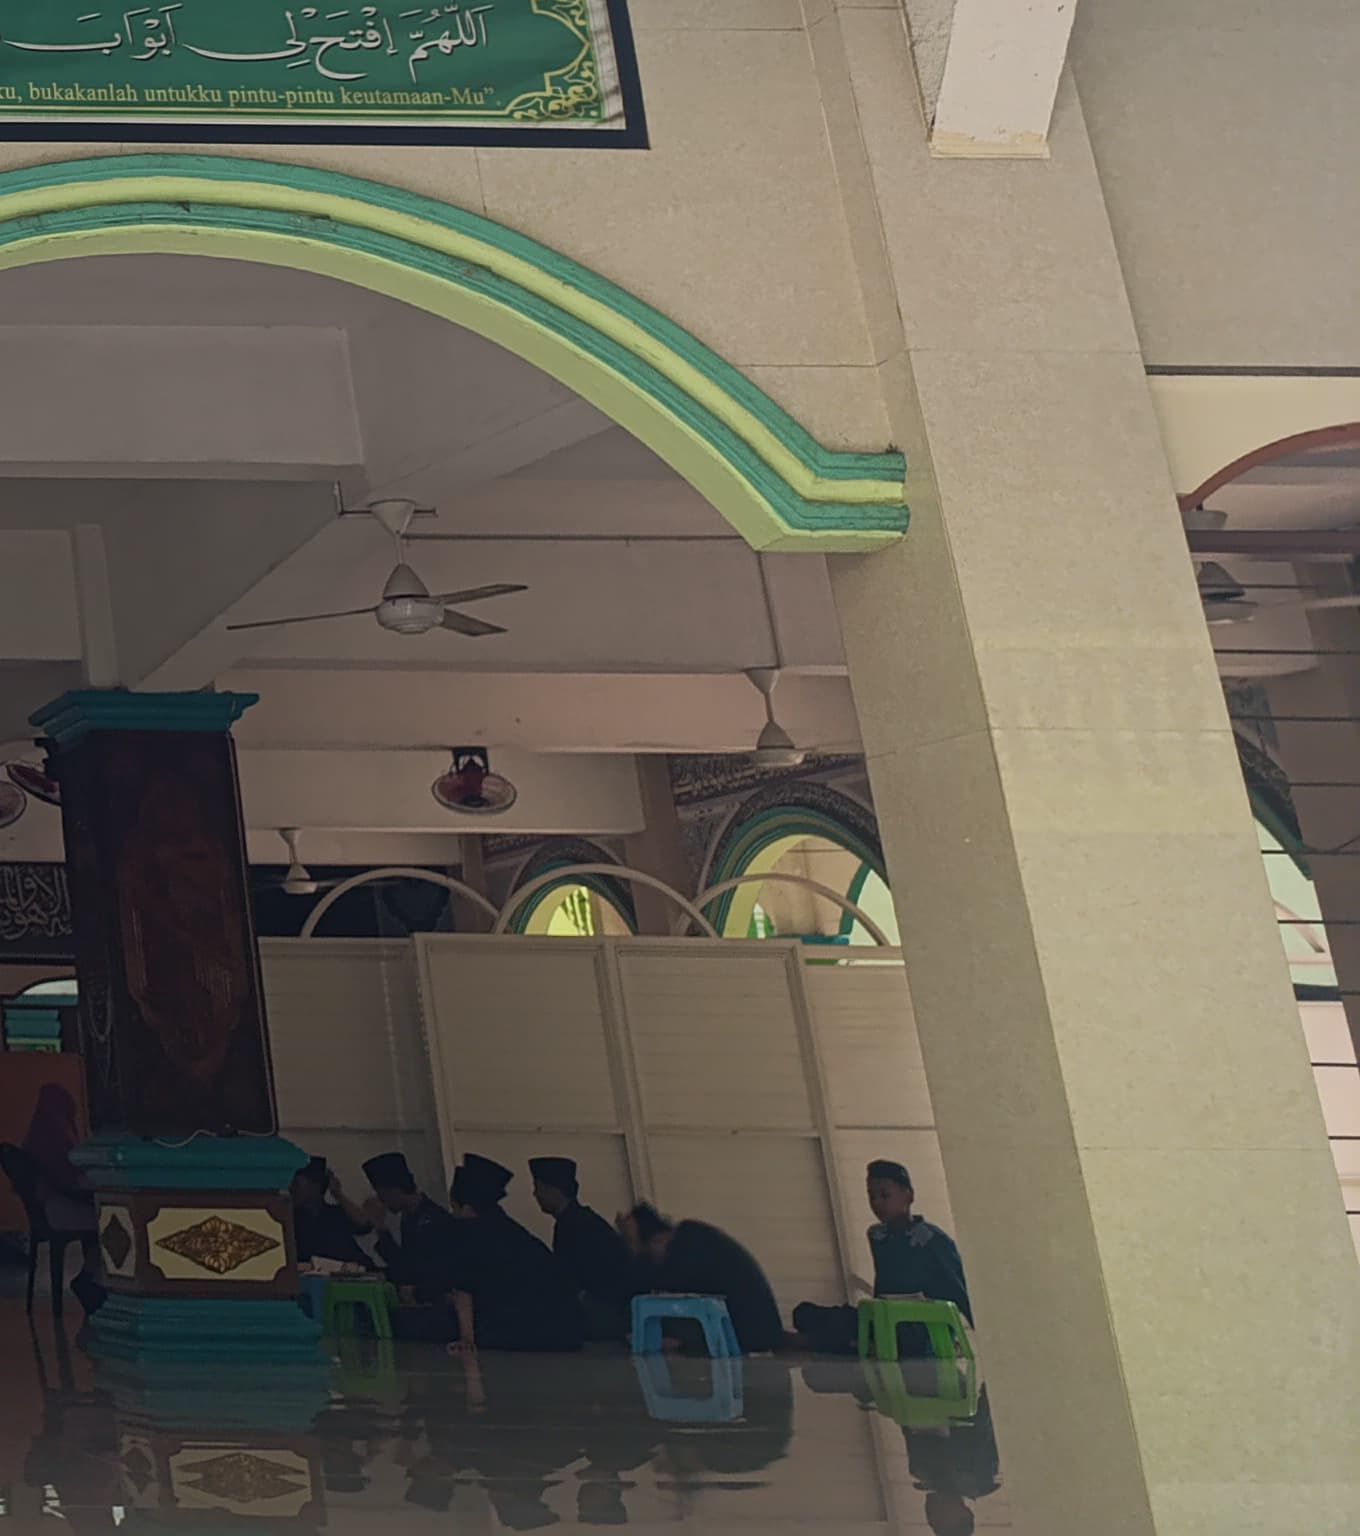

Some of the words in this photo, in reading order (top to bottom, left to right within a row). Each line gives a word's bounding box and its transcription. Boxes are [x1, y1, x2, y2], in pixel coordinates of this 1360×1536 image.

[29, 82, 138, 103] bukakanlah
[144, 85, 222, 104] untukku
[228, 86, 335, 107] pintu-pintu
